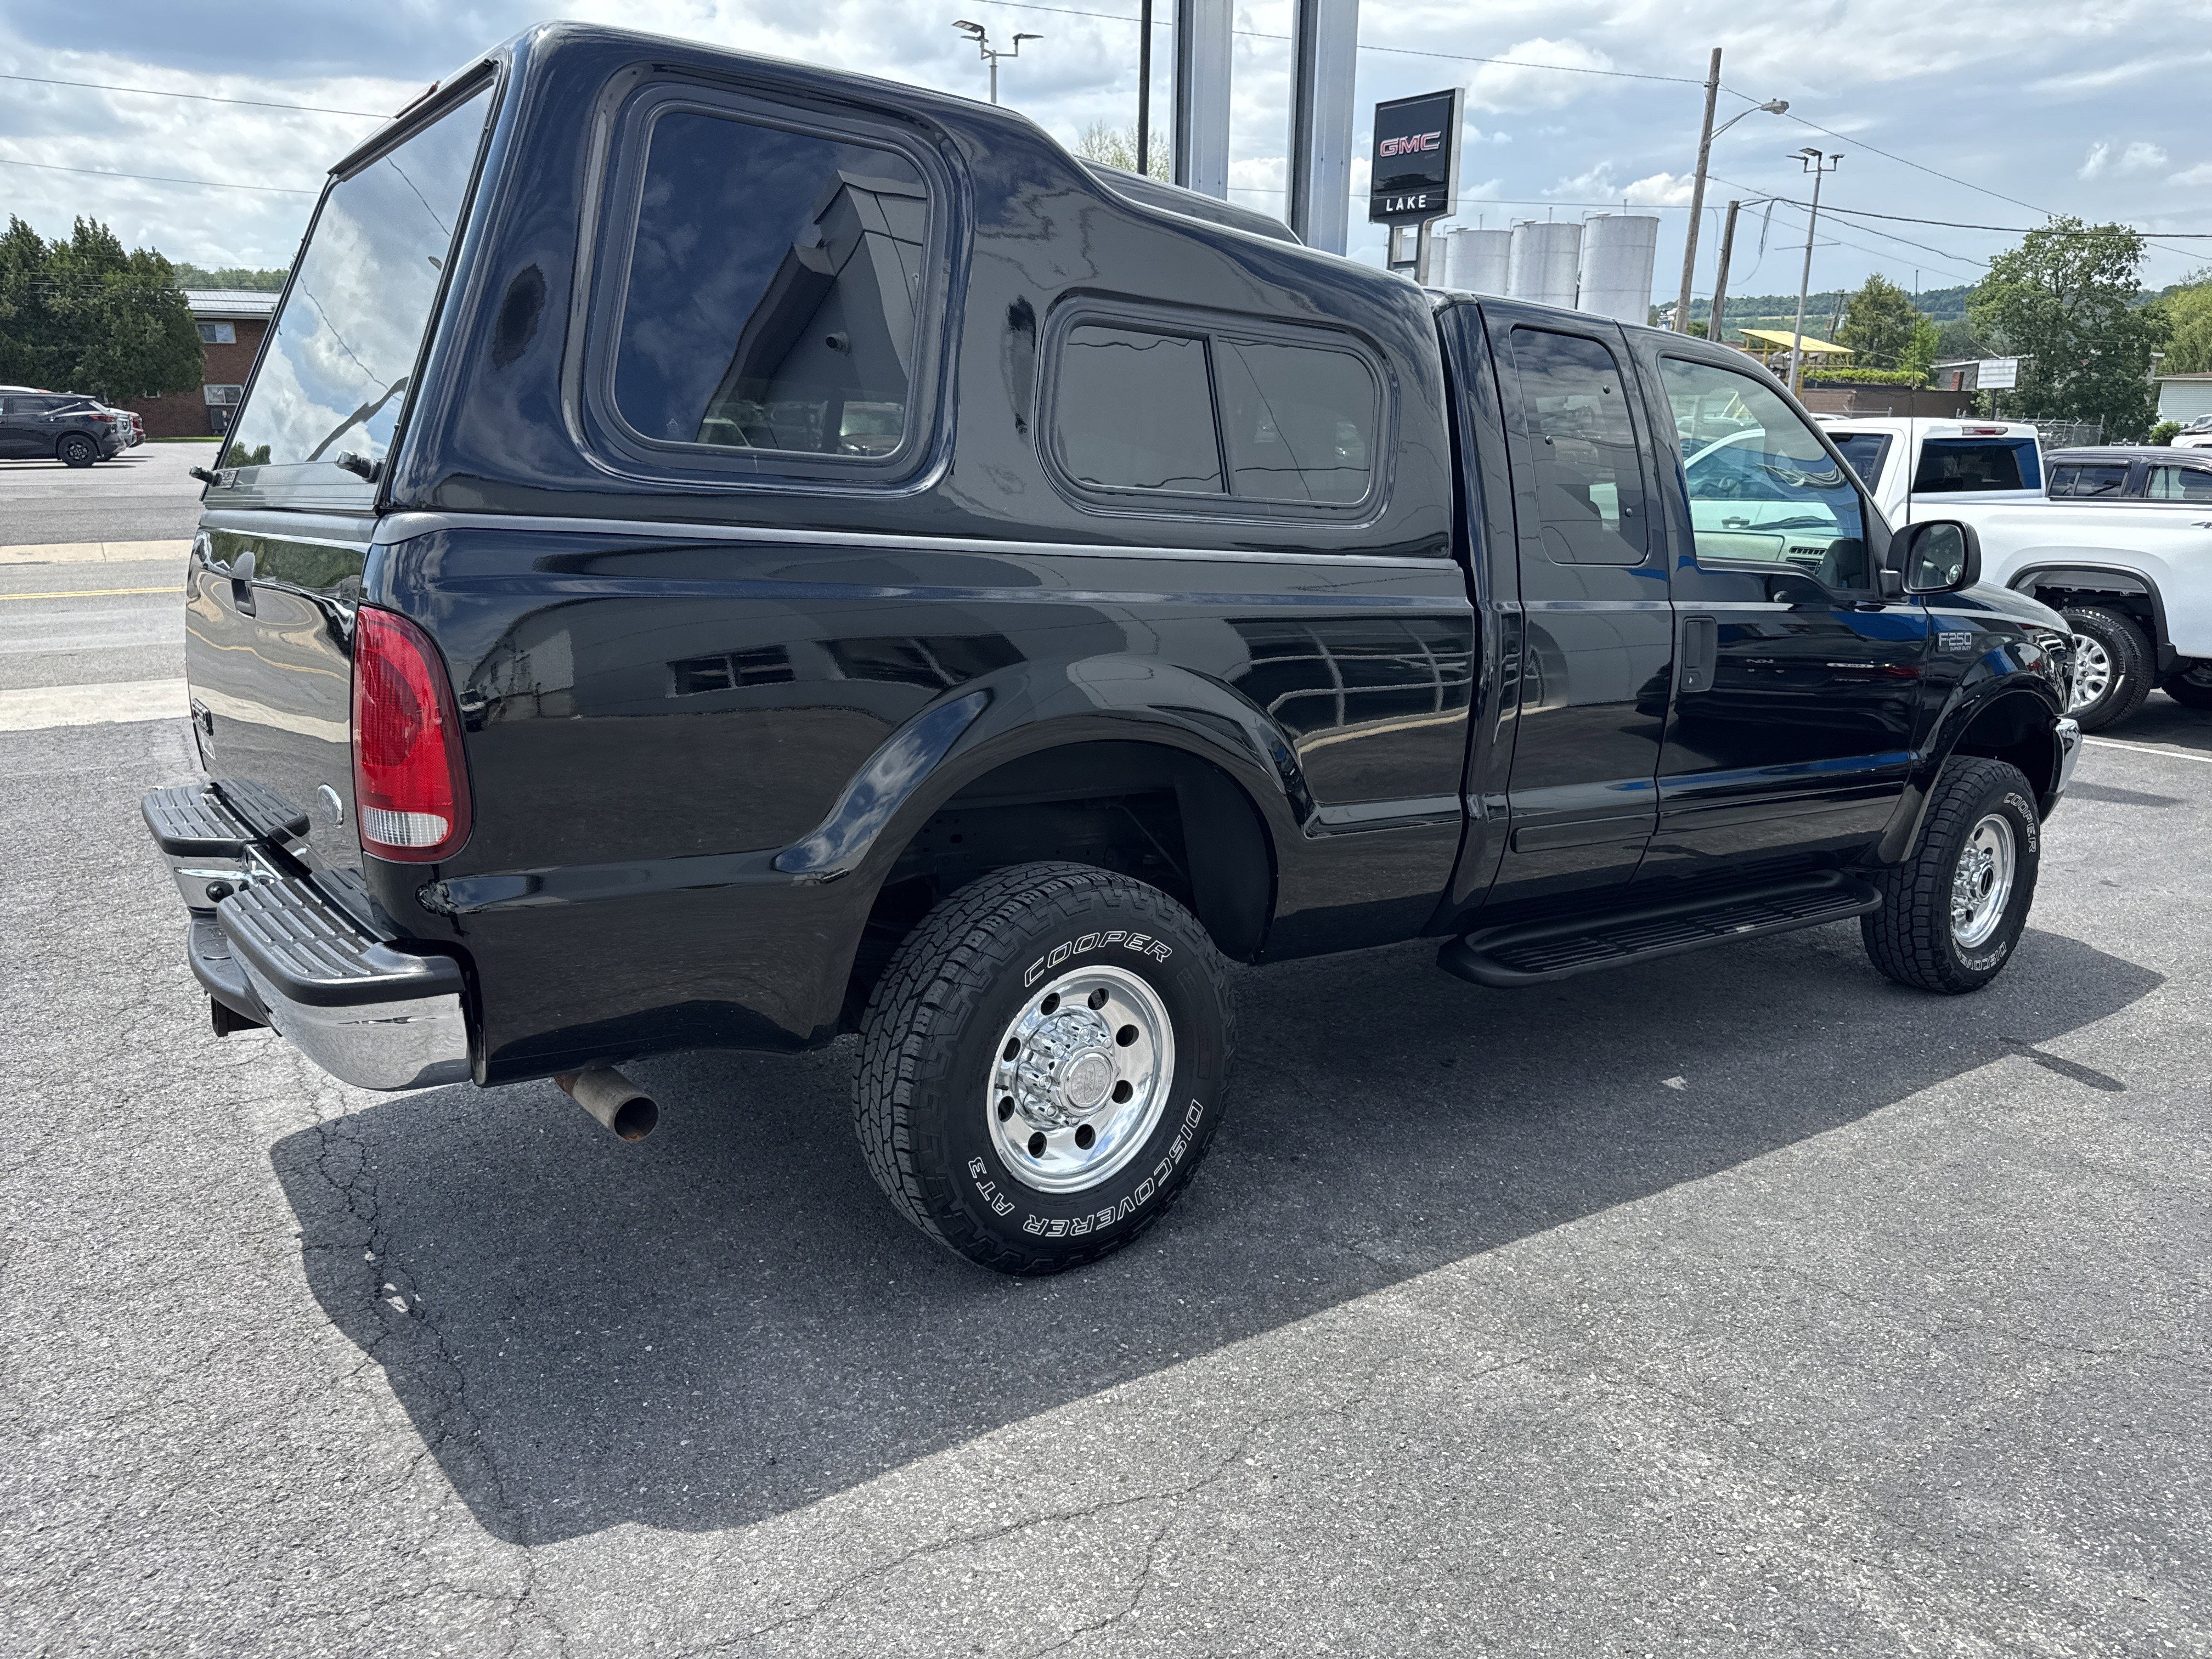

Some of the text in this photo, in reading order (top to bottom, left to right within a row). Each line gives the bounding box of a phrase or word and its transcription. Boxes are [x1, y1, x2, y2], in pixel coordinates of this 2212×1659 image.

[1380, 131, 1441, 157] GMC
[1386, 195, 1426, 212] LAKE
[2003, 792, 2036, 854] COOPER
[1024, 930, 1172, 988] COOPER
[967, 1098, 1204, 1237] DISCOVERER AT3
